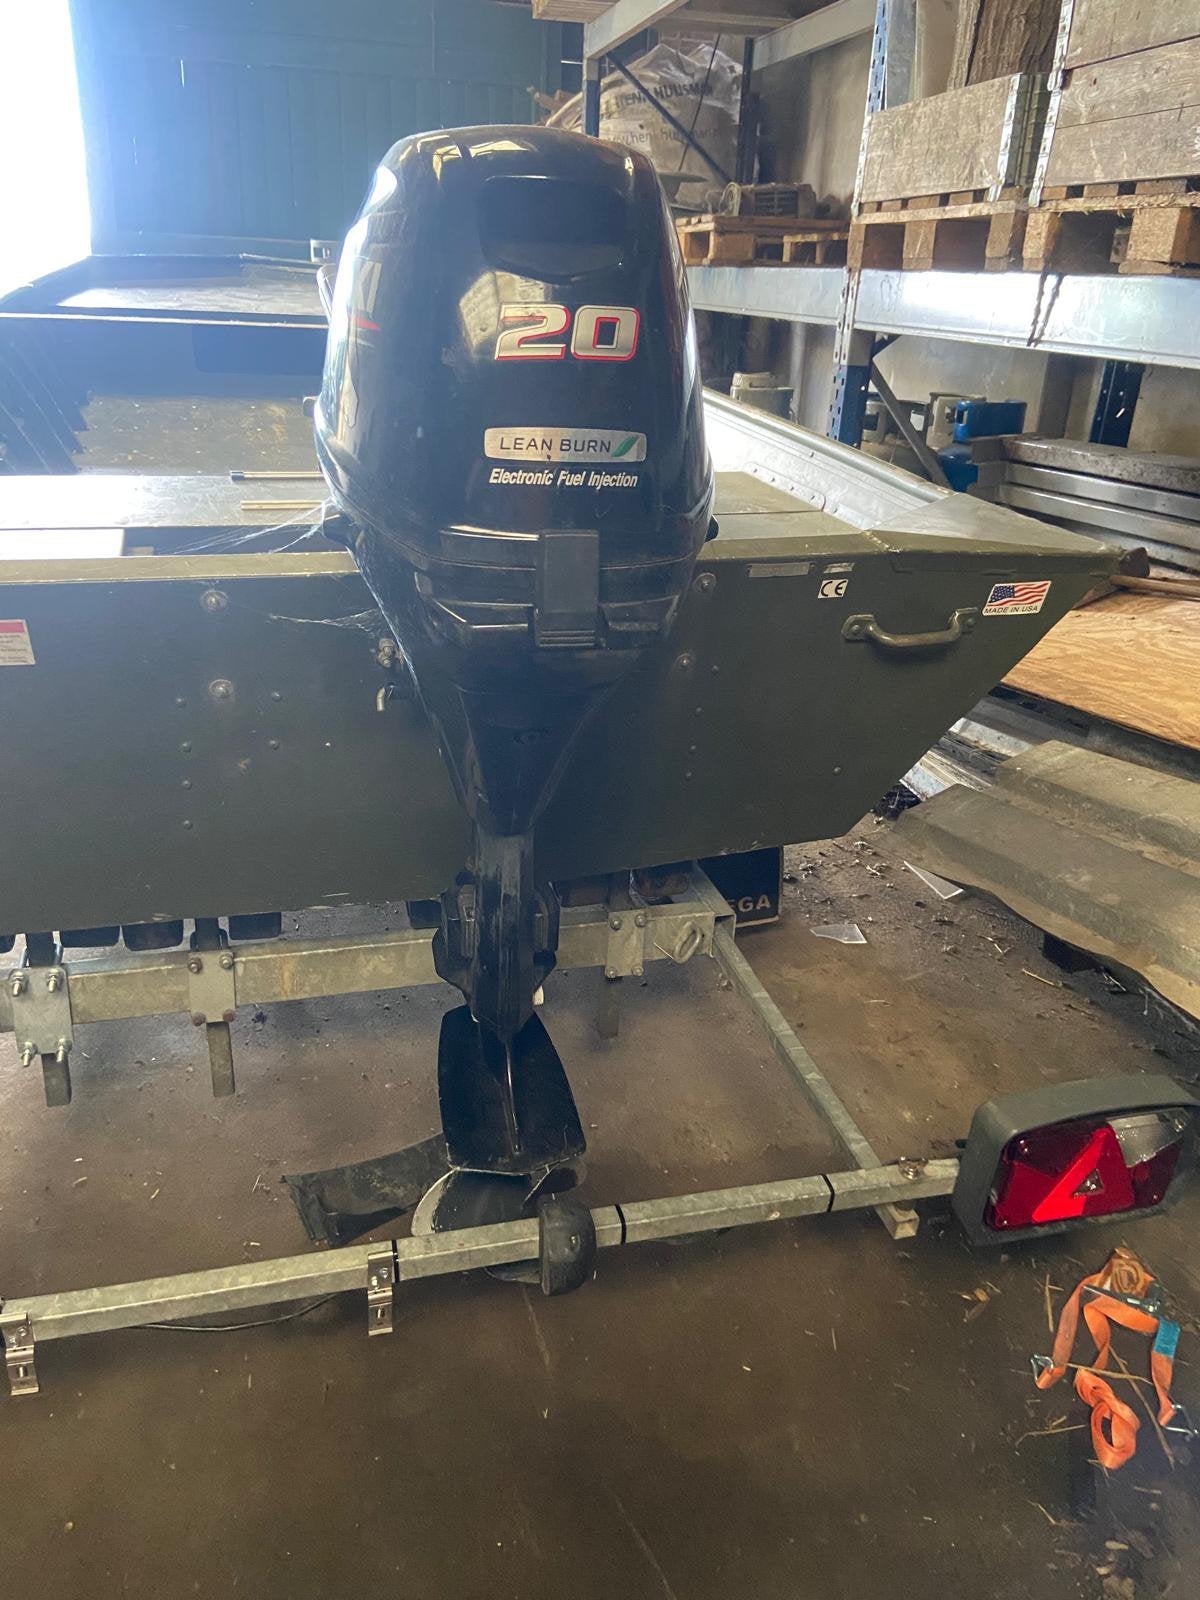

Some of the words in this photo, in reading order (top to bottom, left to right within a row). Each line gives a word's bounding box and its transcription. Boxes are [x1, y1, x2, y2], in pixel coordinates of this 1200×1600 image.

[495, 304, 641, 361] 20
[500, 437, 553, 451] LEAN
[559, 438, 612, 453] BURN
[489, 468, 554, 485] Electronic
[556, 470, 586, 487] Fuel
[587, 472, 639, 490] Injection
[820, 580, 848, 598] CE
[984, 606, 1009, 614] MADE
[1021, 605, 1038, 613] USA
